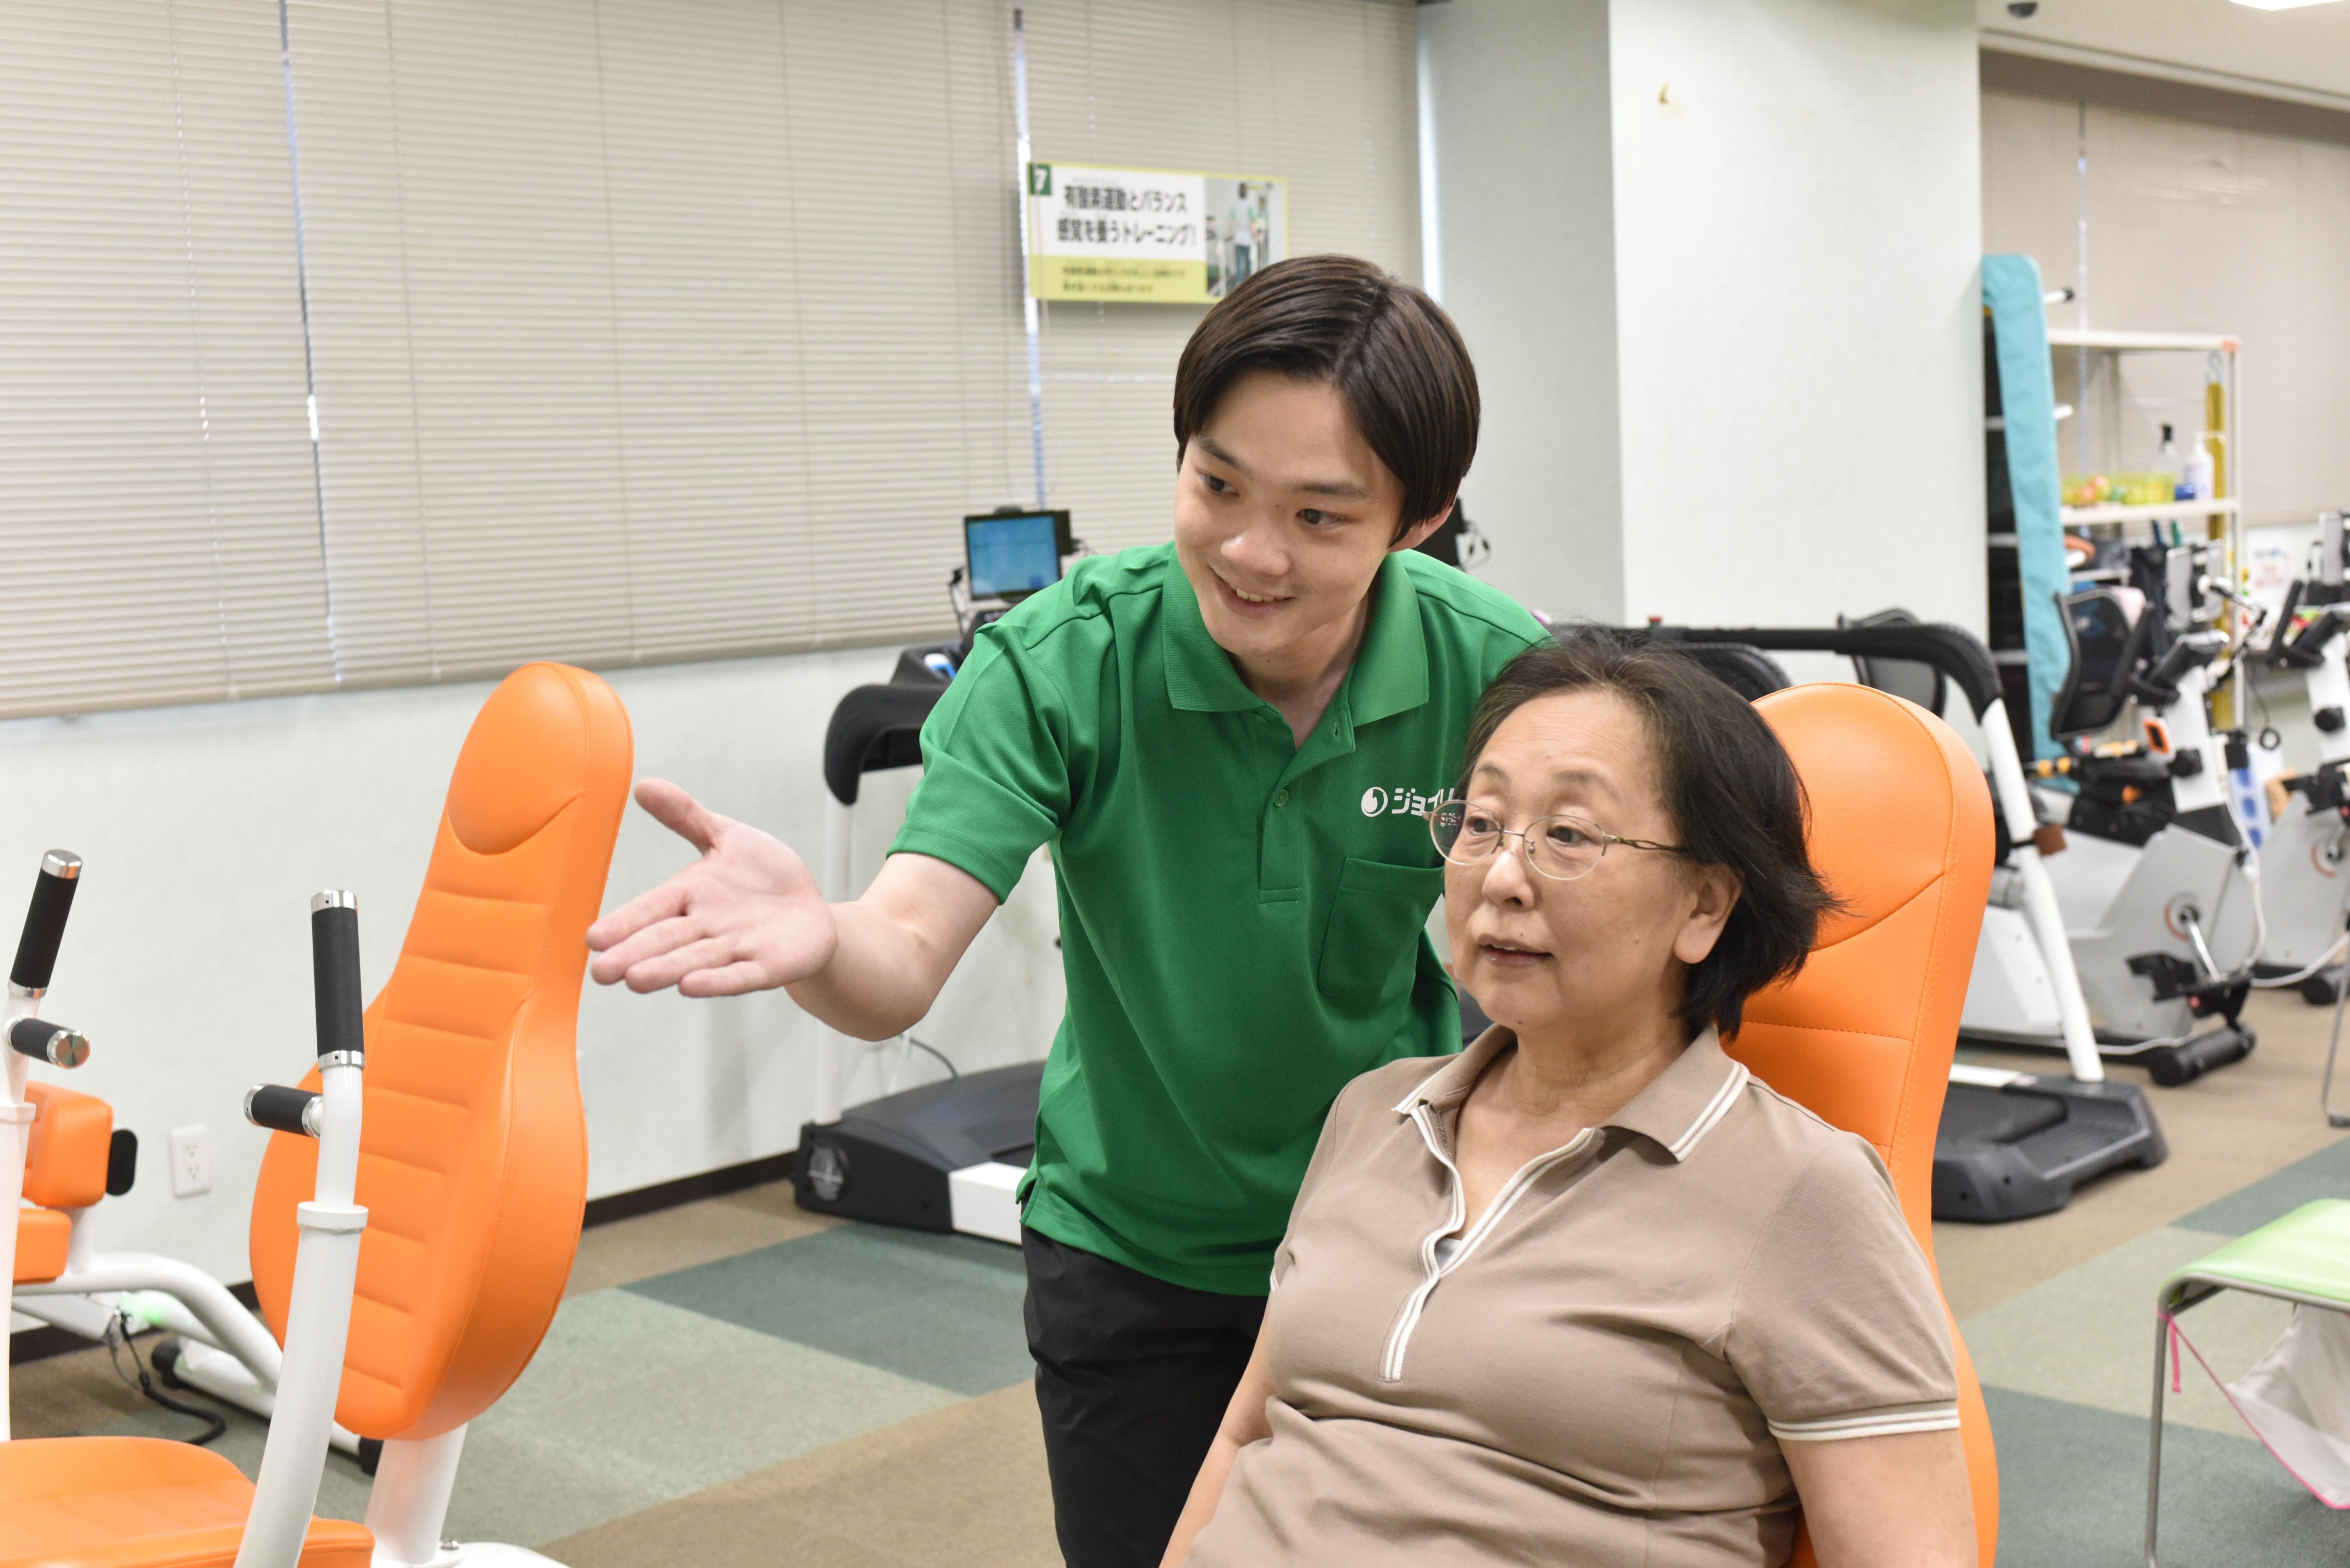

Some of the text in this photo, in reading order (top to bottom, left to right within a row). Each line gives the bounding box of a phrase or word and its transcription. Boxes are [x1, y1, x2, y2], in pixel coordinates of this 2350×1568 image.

[1034, 168, 1048, 191] 7
[1065, 185, 1188, 213] 有酸素運動とバランス
